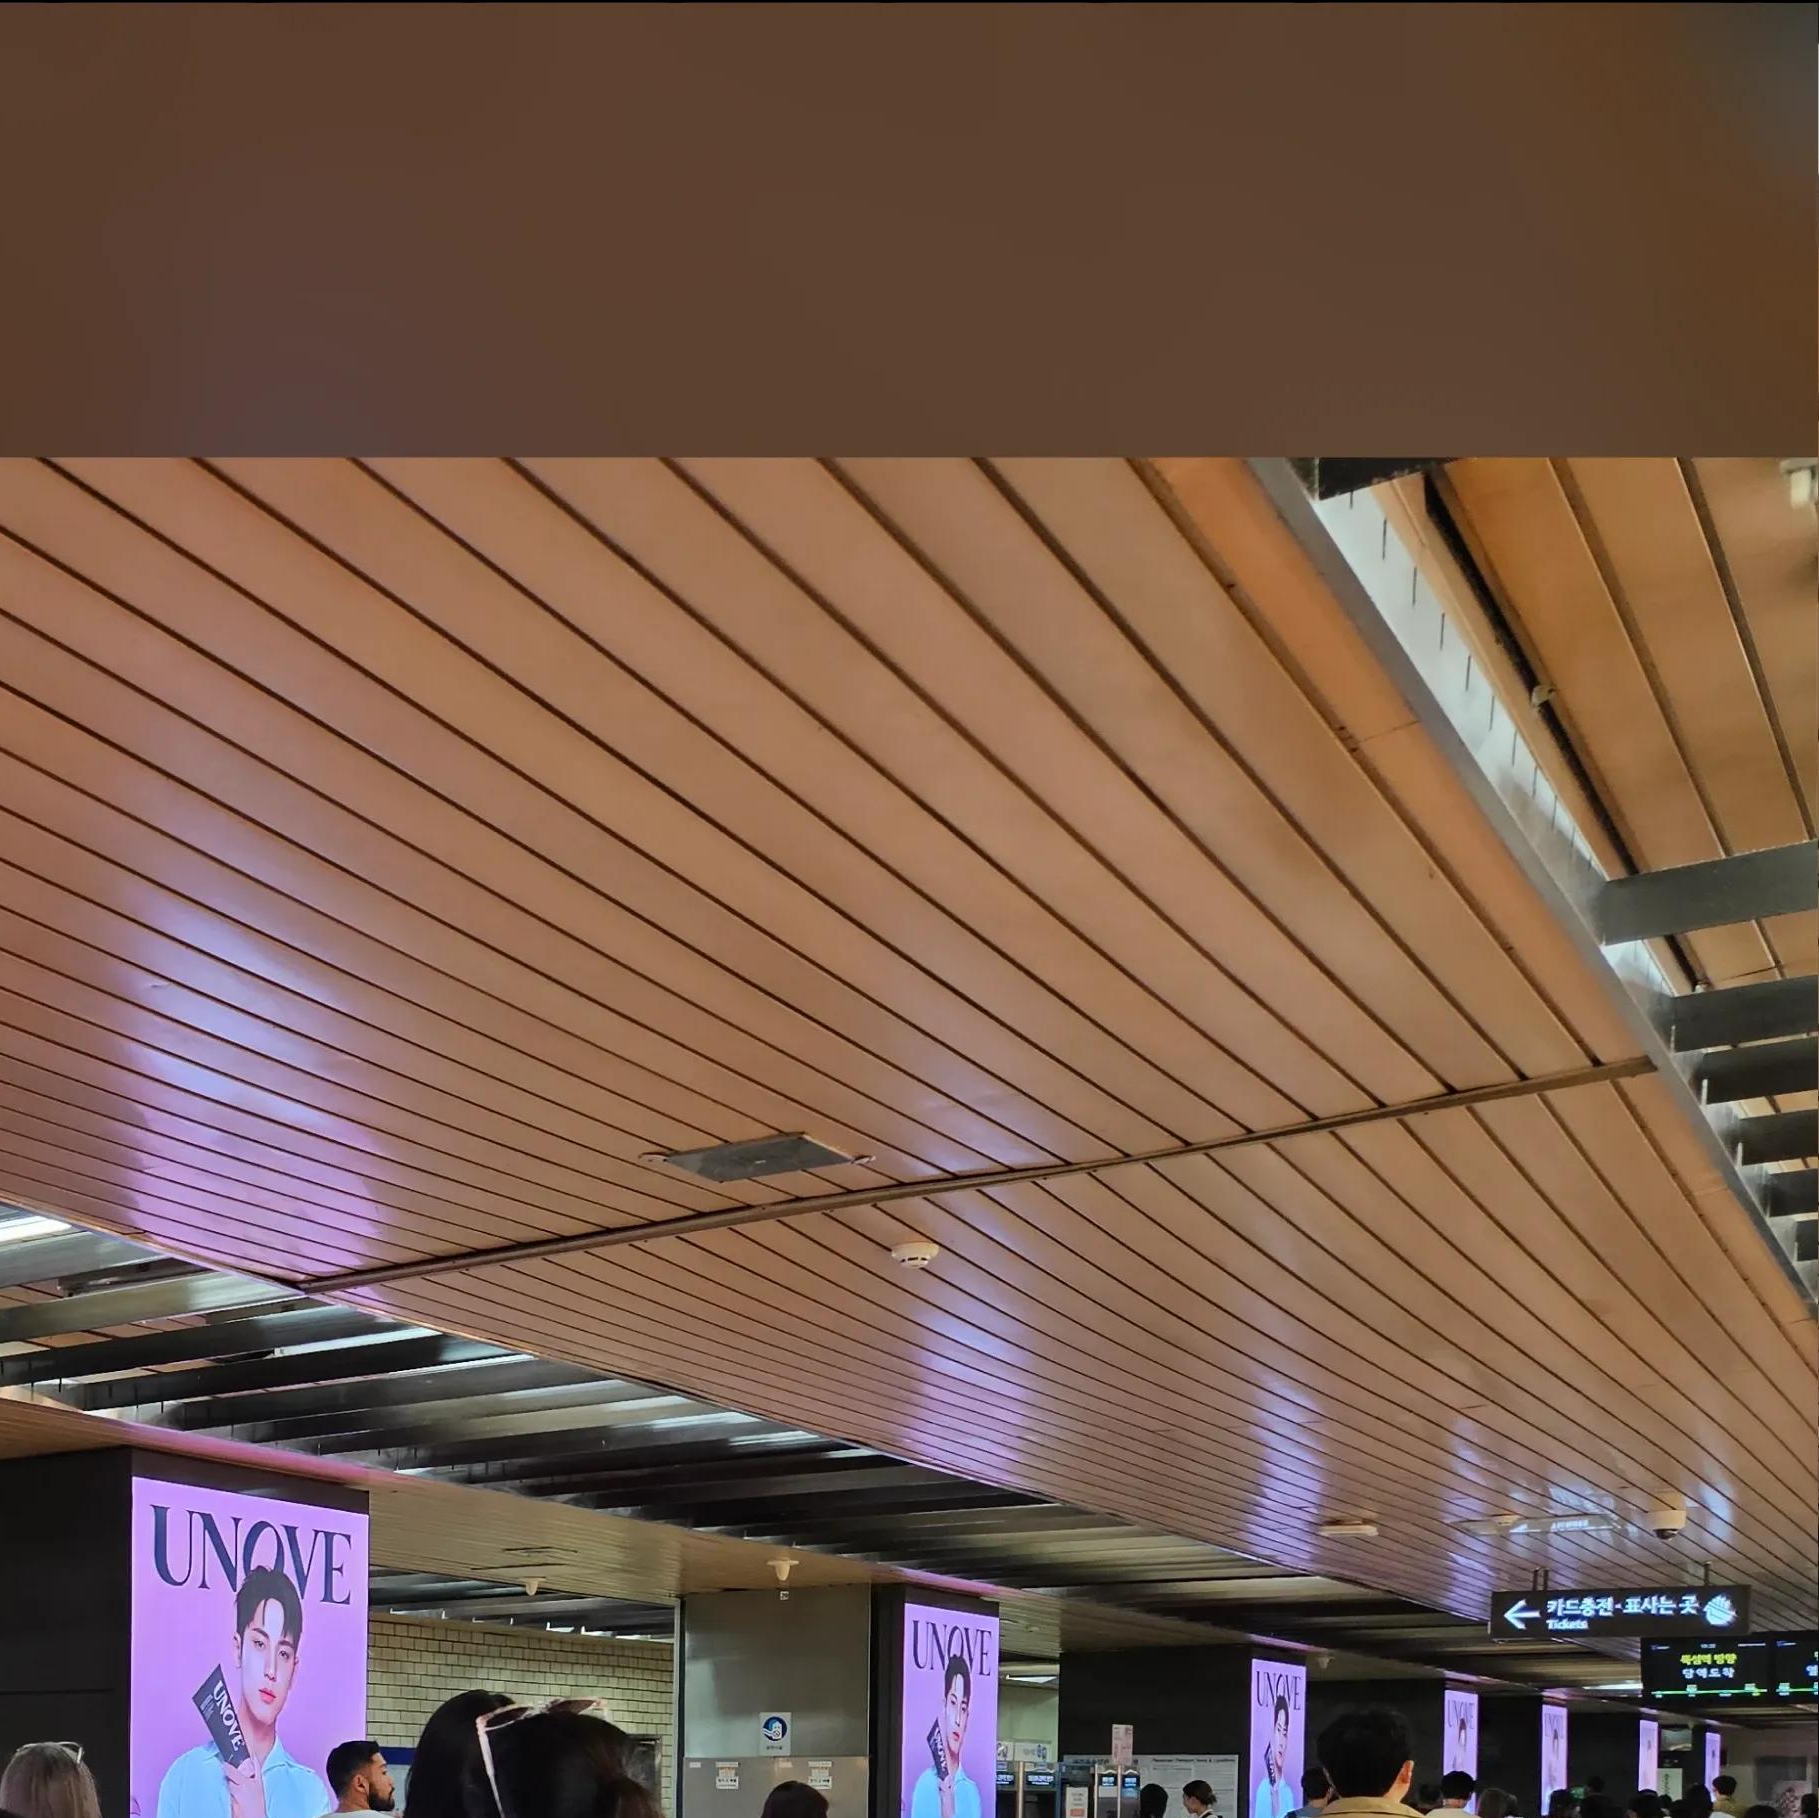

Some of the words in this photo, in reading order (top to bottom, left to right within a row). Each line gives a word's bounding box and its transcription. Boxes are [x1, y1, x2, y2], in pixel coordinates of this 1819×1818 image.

[150, 1504, 352, 1605] UNOVE
[912, 1620, 992, 1676] UNOVE
[1546, 1618, 1589, 1630] Tickets
[213, 1680, 245, 1752] UNOVE
[1256, 1670, 1302, 1711] UNOVE
